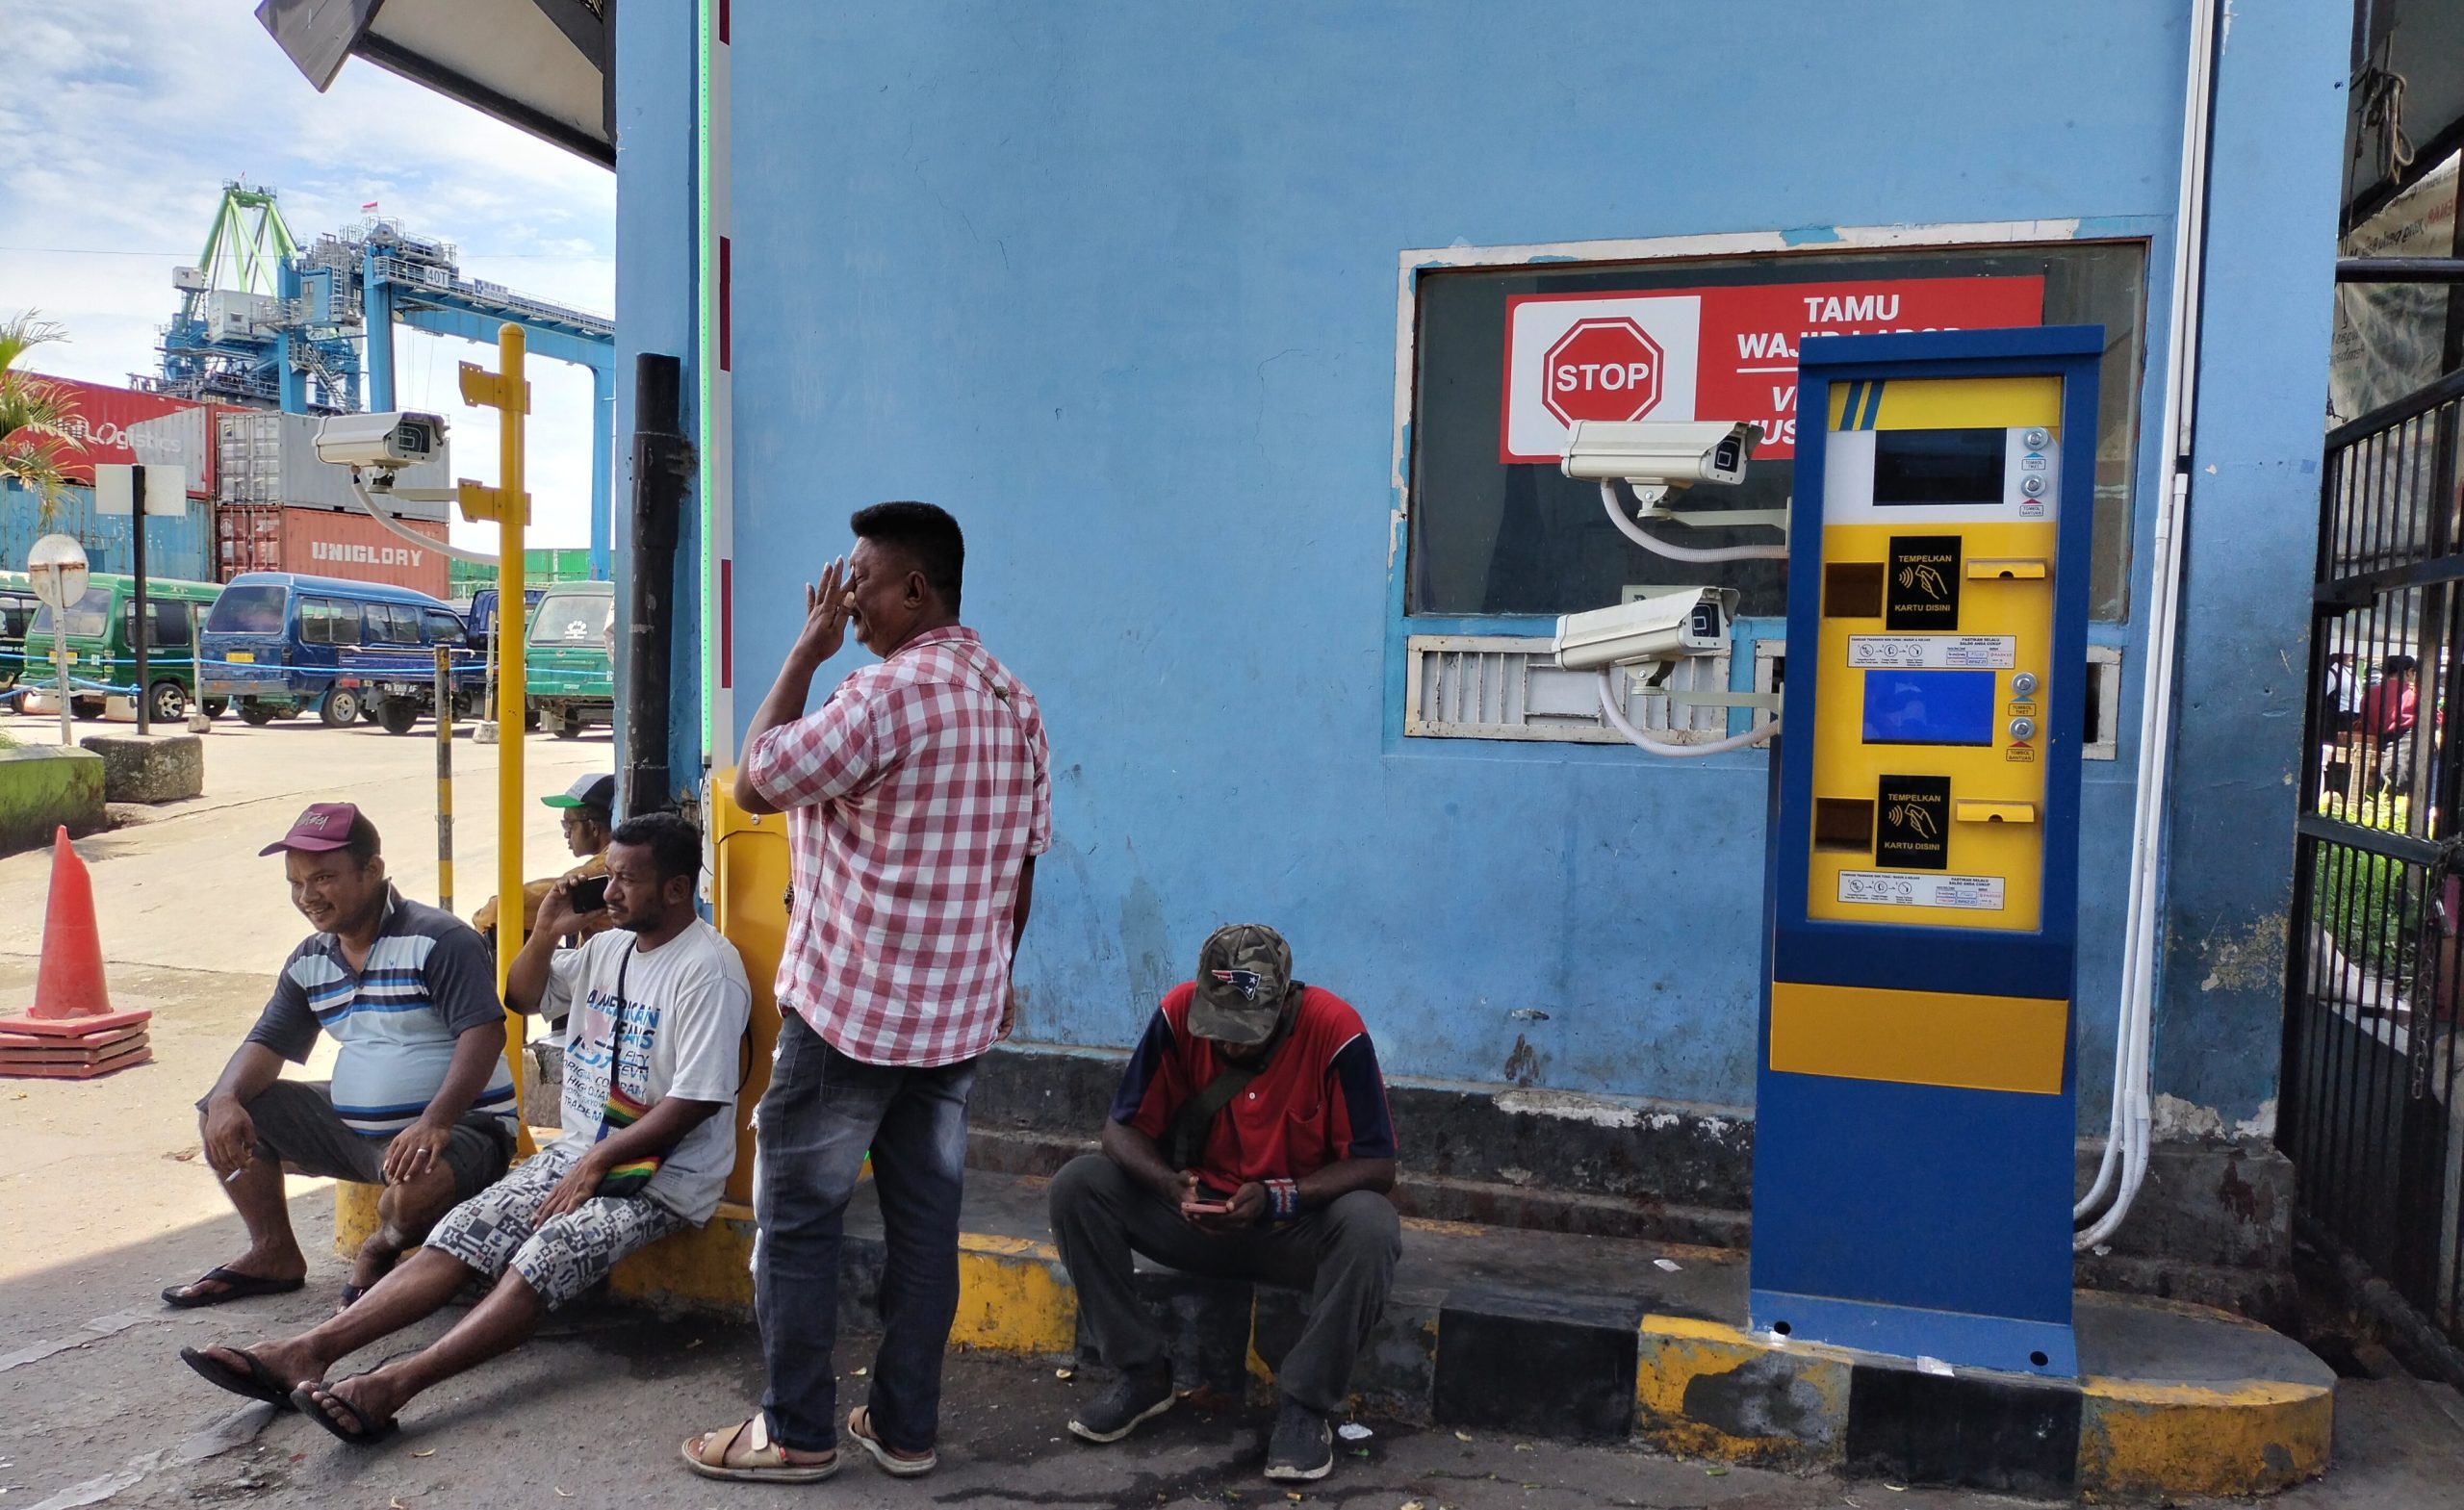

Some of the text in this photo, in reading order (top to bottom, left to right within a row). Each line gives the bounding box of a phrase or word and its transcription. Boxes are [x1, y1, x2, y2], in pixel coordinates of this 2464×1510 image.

[427, 269, 448, 285] 40T
[1803, 294, 1900, 322] TAMU
[1556, 363, 1650, 392] STOP
[312, 541, 423, 567] UNIGLORY
[1898, 554, 1952, 563] TEMPELKAN
[1887, 793, 1941, 802] TEMPELKAN
[1914, 842, 1940, 851] DISINI
